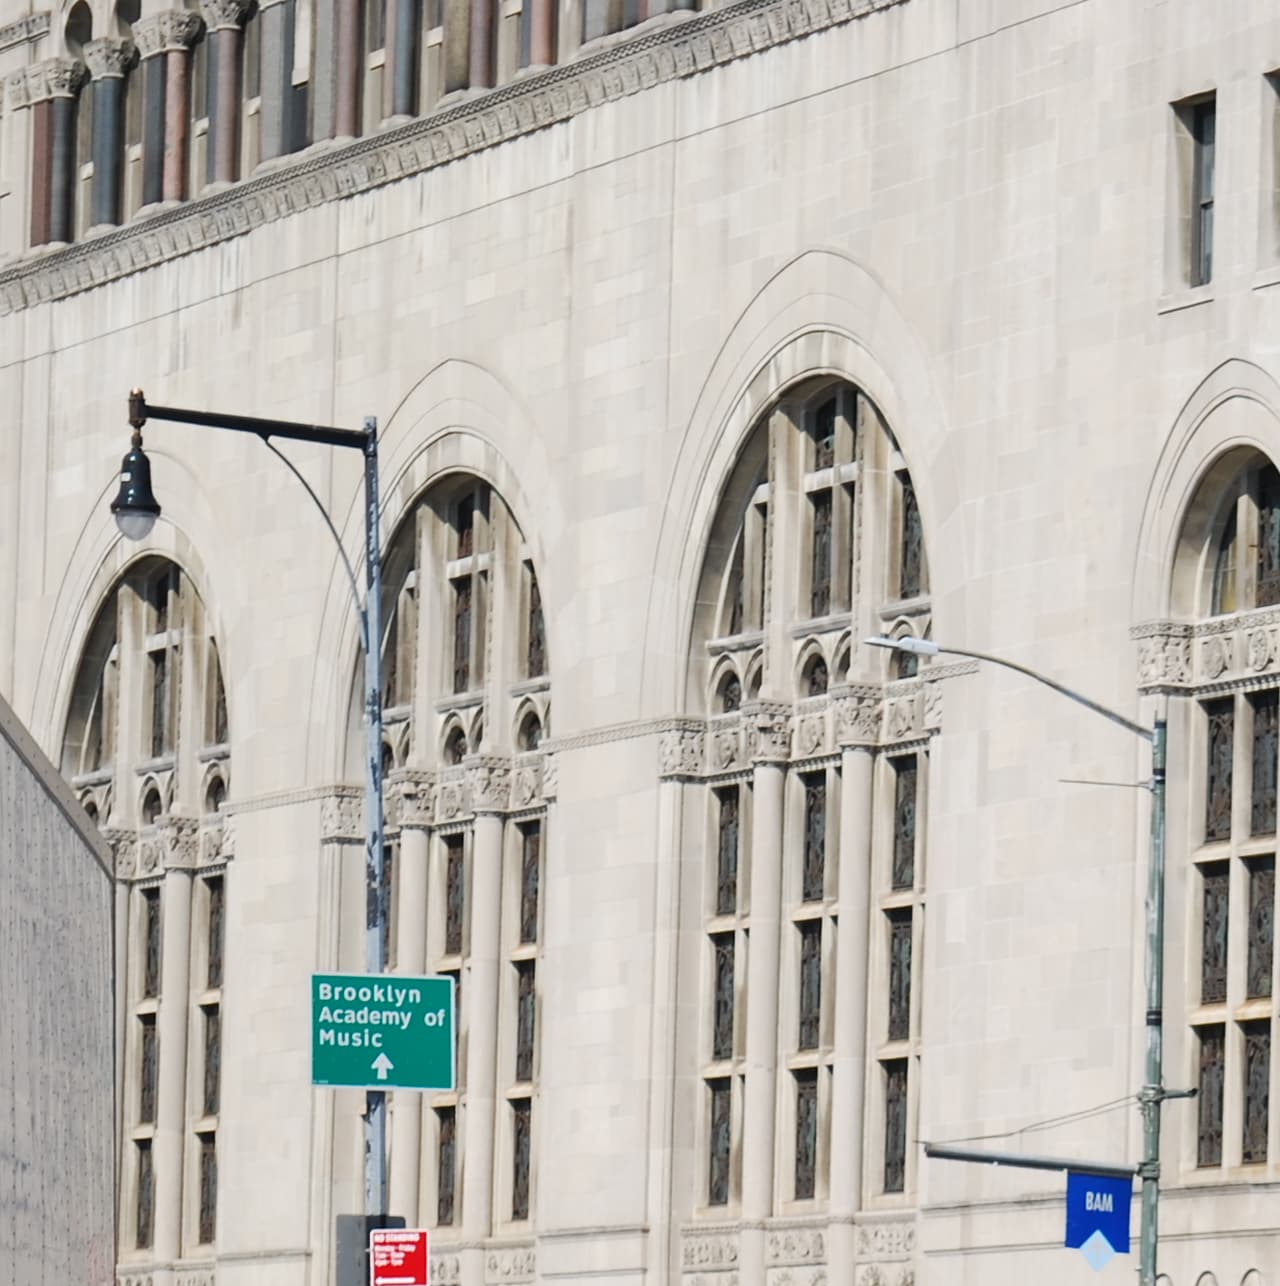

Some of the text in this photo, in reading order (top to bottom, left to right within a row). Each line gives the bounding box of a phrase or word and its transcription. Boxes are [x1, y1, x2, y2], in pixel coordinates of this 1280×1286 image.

[318, 983, 422, 1007] Brooklyn
[318, 1006, 446, 1030] Academy of
[319, 1028, 384, 1048] Music
[1085, 1191, 1114, 1213] BAM
